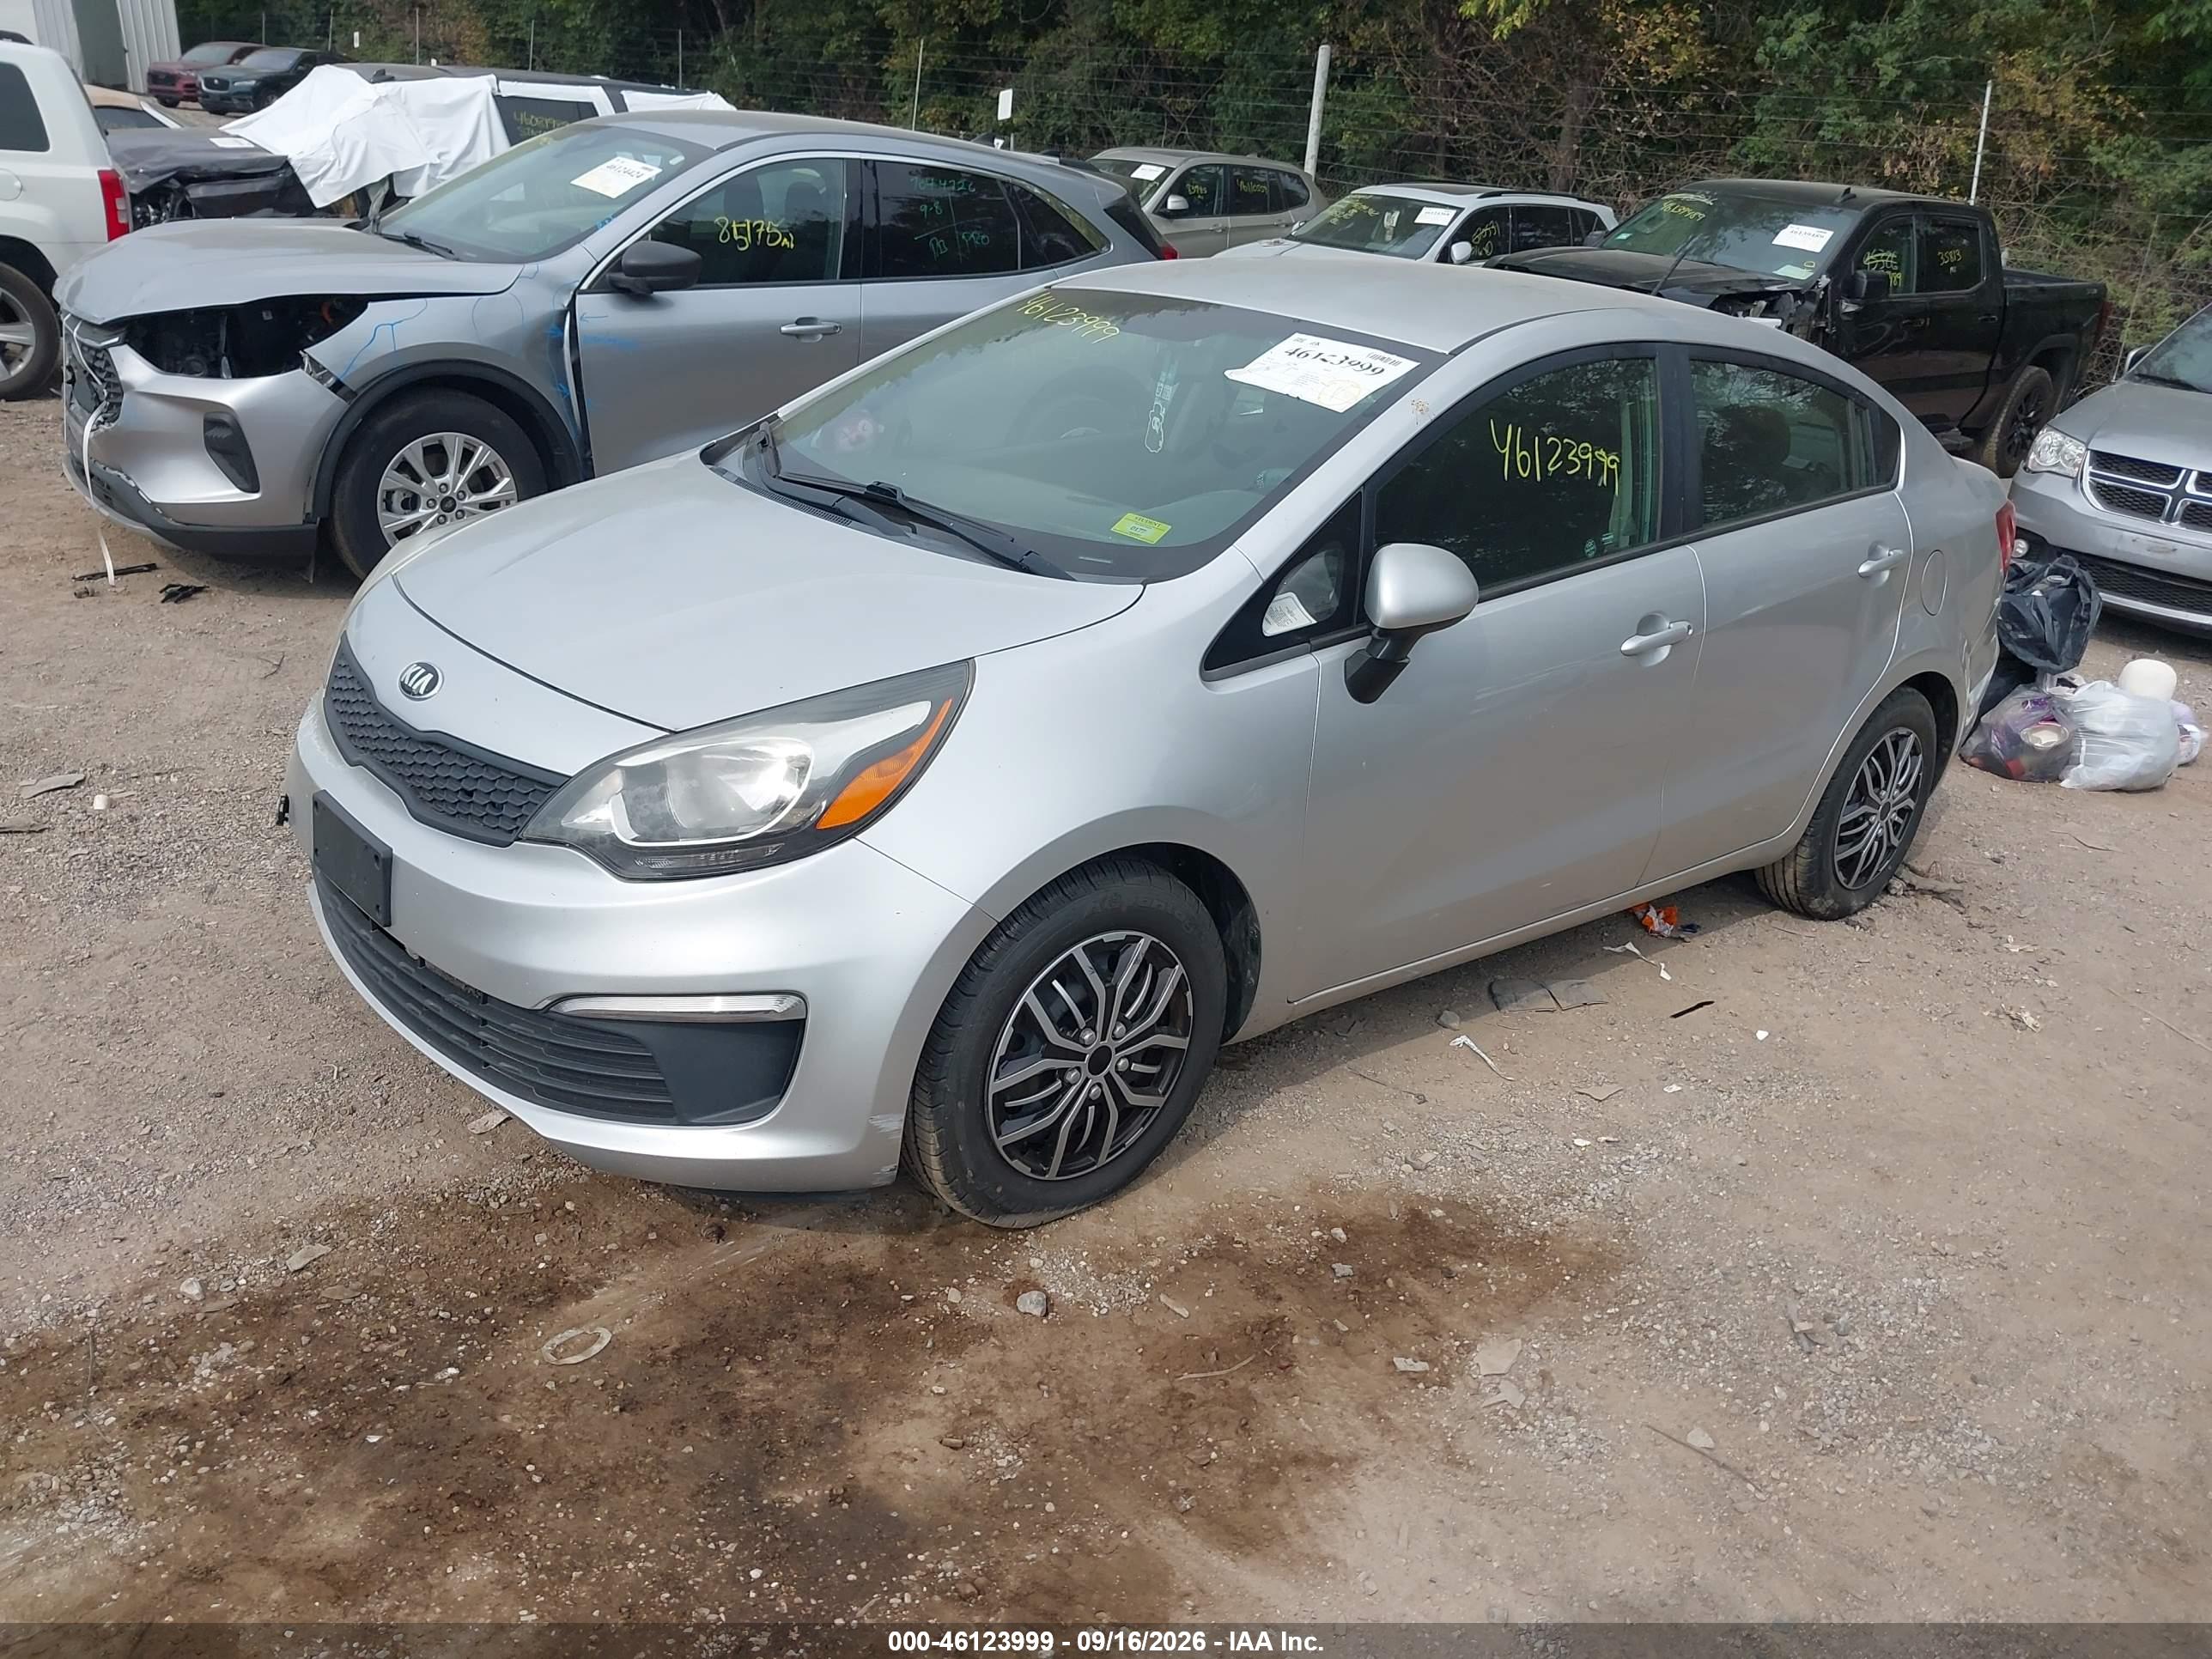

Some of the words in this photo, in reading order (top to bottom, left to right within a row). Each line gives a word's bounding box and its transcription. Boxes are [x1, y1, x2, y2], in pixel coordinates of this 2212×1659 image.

[1017, 292, 1120, 343] 46123999
[1490, 418, 1620, 497] 46123999
[400, 664, 434, 695] KIA
